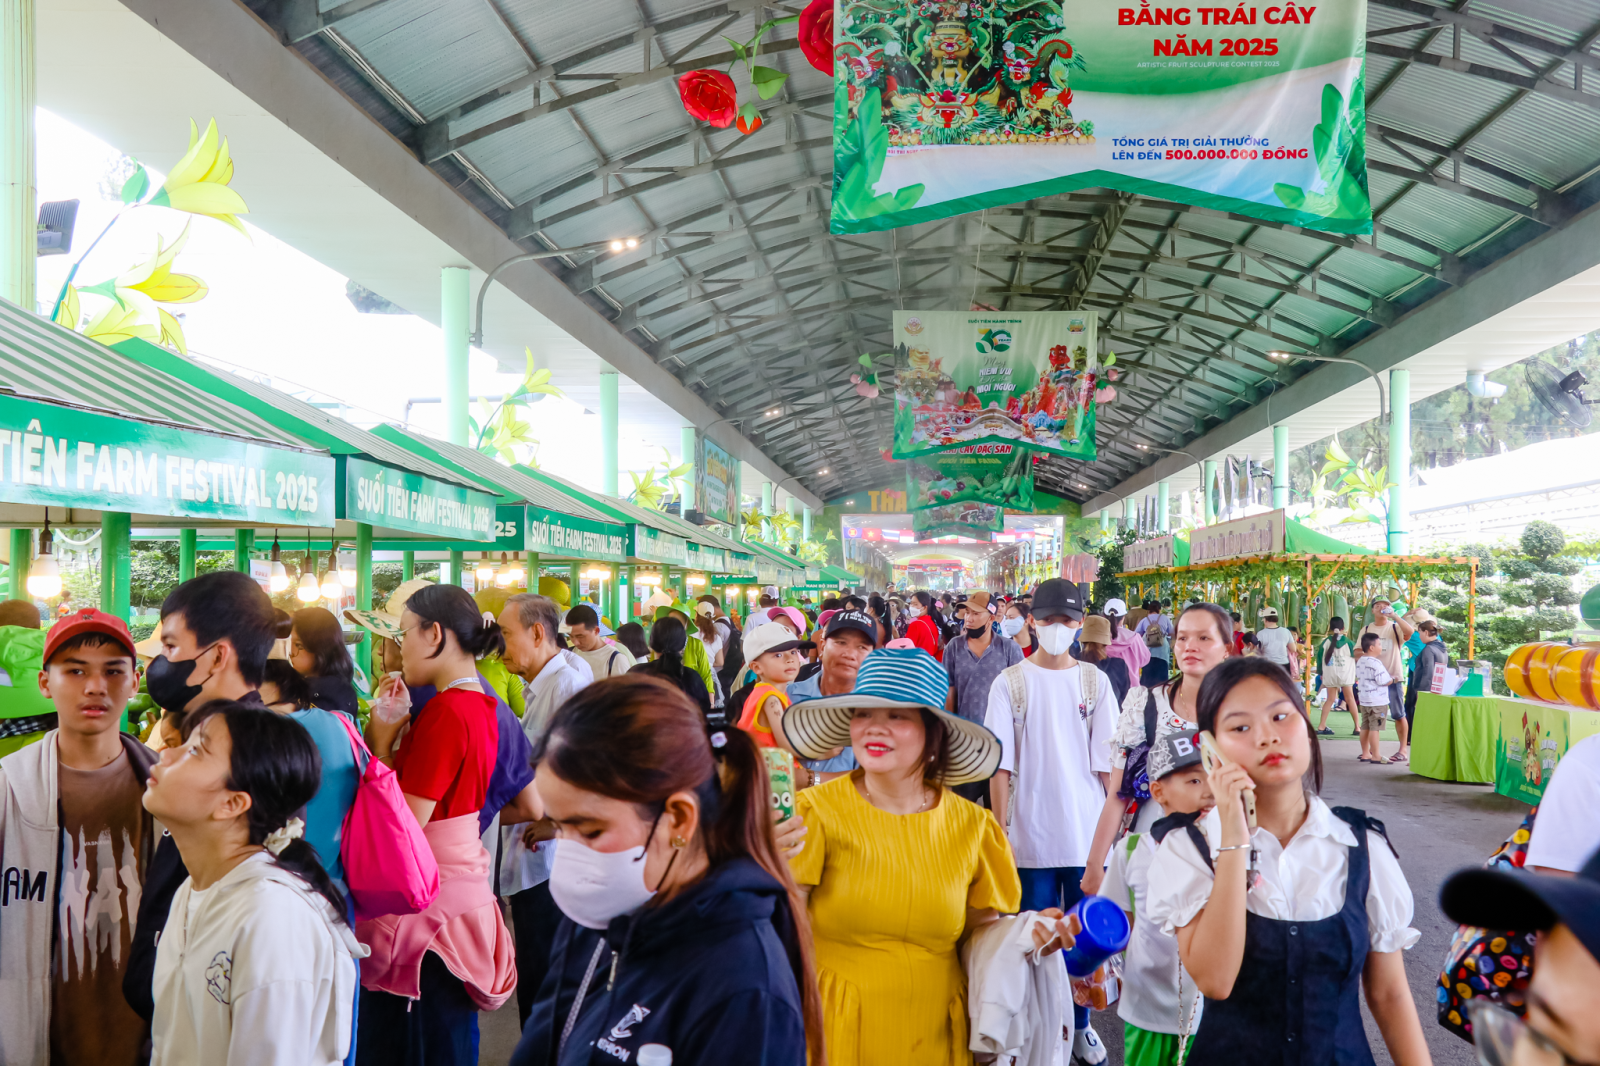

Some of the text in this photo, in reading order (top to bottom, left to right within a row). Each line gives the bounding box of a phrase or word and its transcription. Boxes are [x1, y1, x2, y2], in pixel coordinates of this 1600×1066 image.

[1197, 2, 1256, 25] TRÁI
[1263, 1, 1317, 25] CÂY
[1153, 34, 1279, 57] NĂM 2025
[1112, 135, 1269, 149] TỔNG GIÁ TRỊ GIẢI THƯỞNG
[1112, 146, 1308, 160] LÊN ĐẾN 500.000.000 ĐỒNG
[0, 418, 318, 513] TIÊN FARM FESTIVAL 2025
[357, 470, 489, 532] SUỐI TIÊN FARM FESTIVAL 2025
[531, 515, 549, 545] SUỐI
[550, 520, 565, 548] TIÊN
[566, 528, 583, 551] FARM
[583, 531, 608, 554] FESTIVAL
[609, 535, 622, 555] 2025
